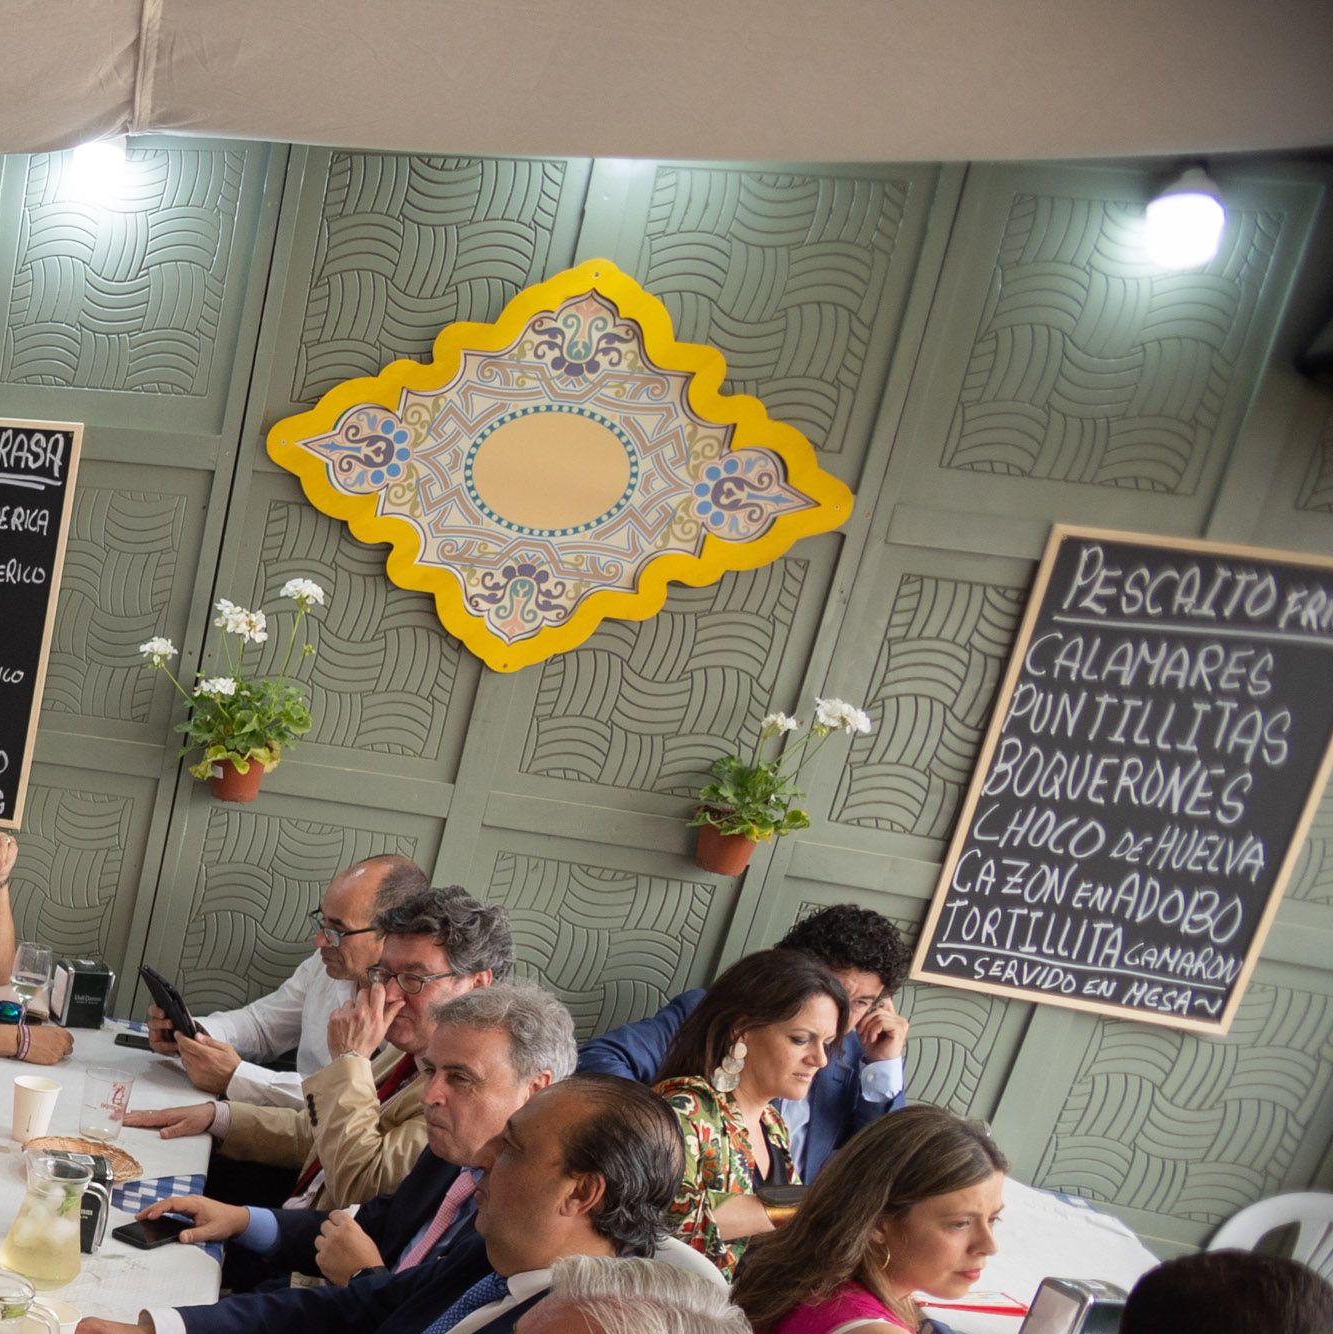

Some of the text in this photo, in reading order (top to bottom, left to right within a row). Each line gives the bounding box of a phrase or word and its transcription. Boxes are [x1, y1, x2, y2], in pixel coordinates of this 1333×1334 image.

[1062, 546, 1278, 620] PESCAITO
[1025, 632, 1274, 696] CALAMARES
[1002, 683, 1291, 765] PUNTILLITAS
[981, 738, 1253, 824] BOQUERONES
[974, 802, 1266, 883] CHOCO DE HUELVA
[952, 849, 1244, 944] CAZON EN ADOBO
[942, 900, 1244, 985] TORTILLITA CAMARON
[974, 956, 1192, 1015] SERVIDO EN MESA
